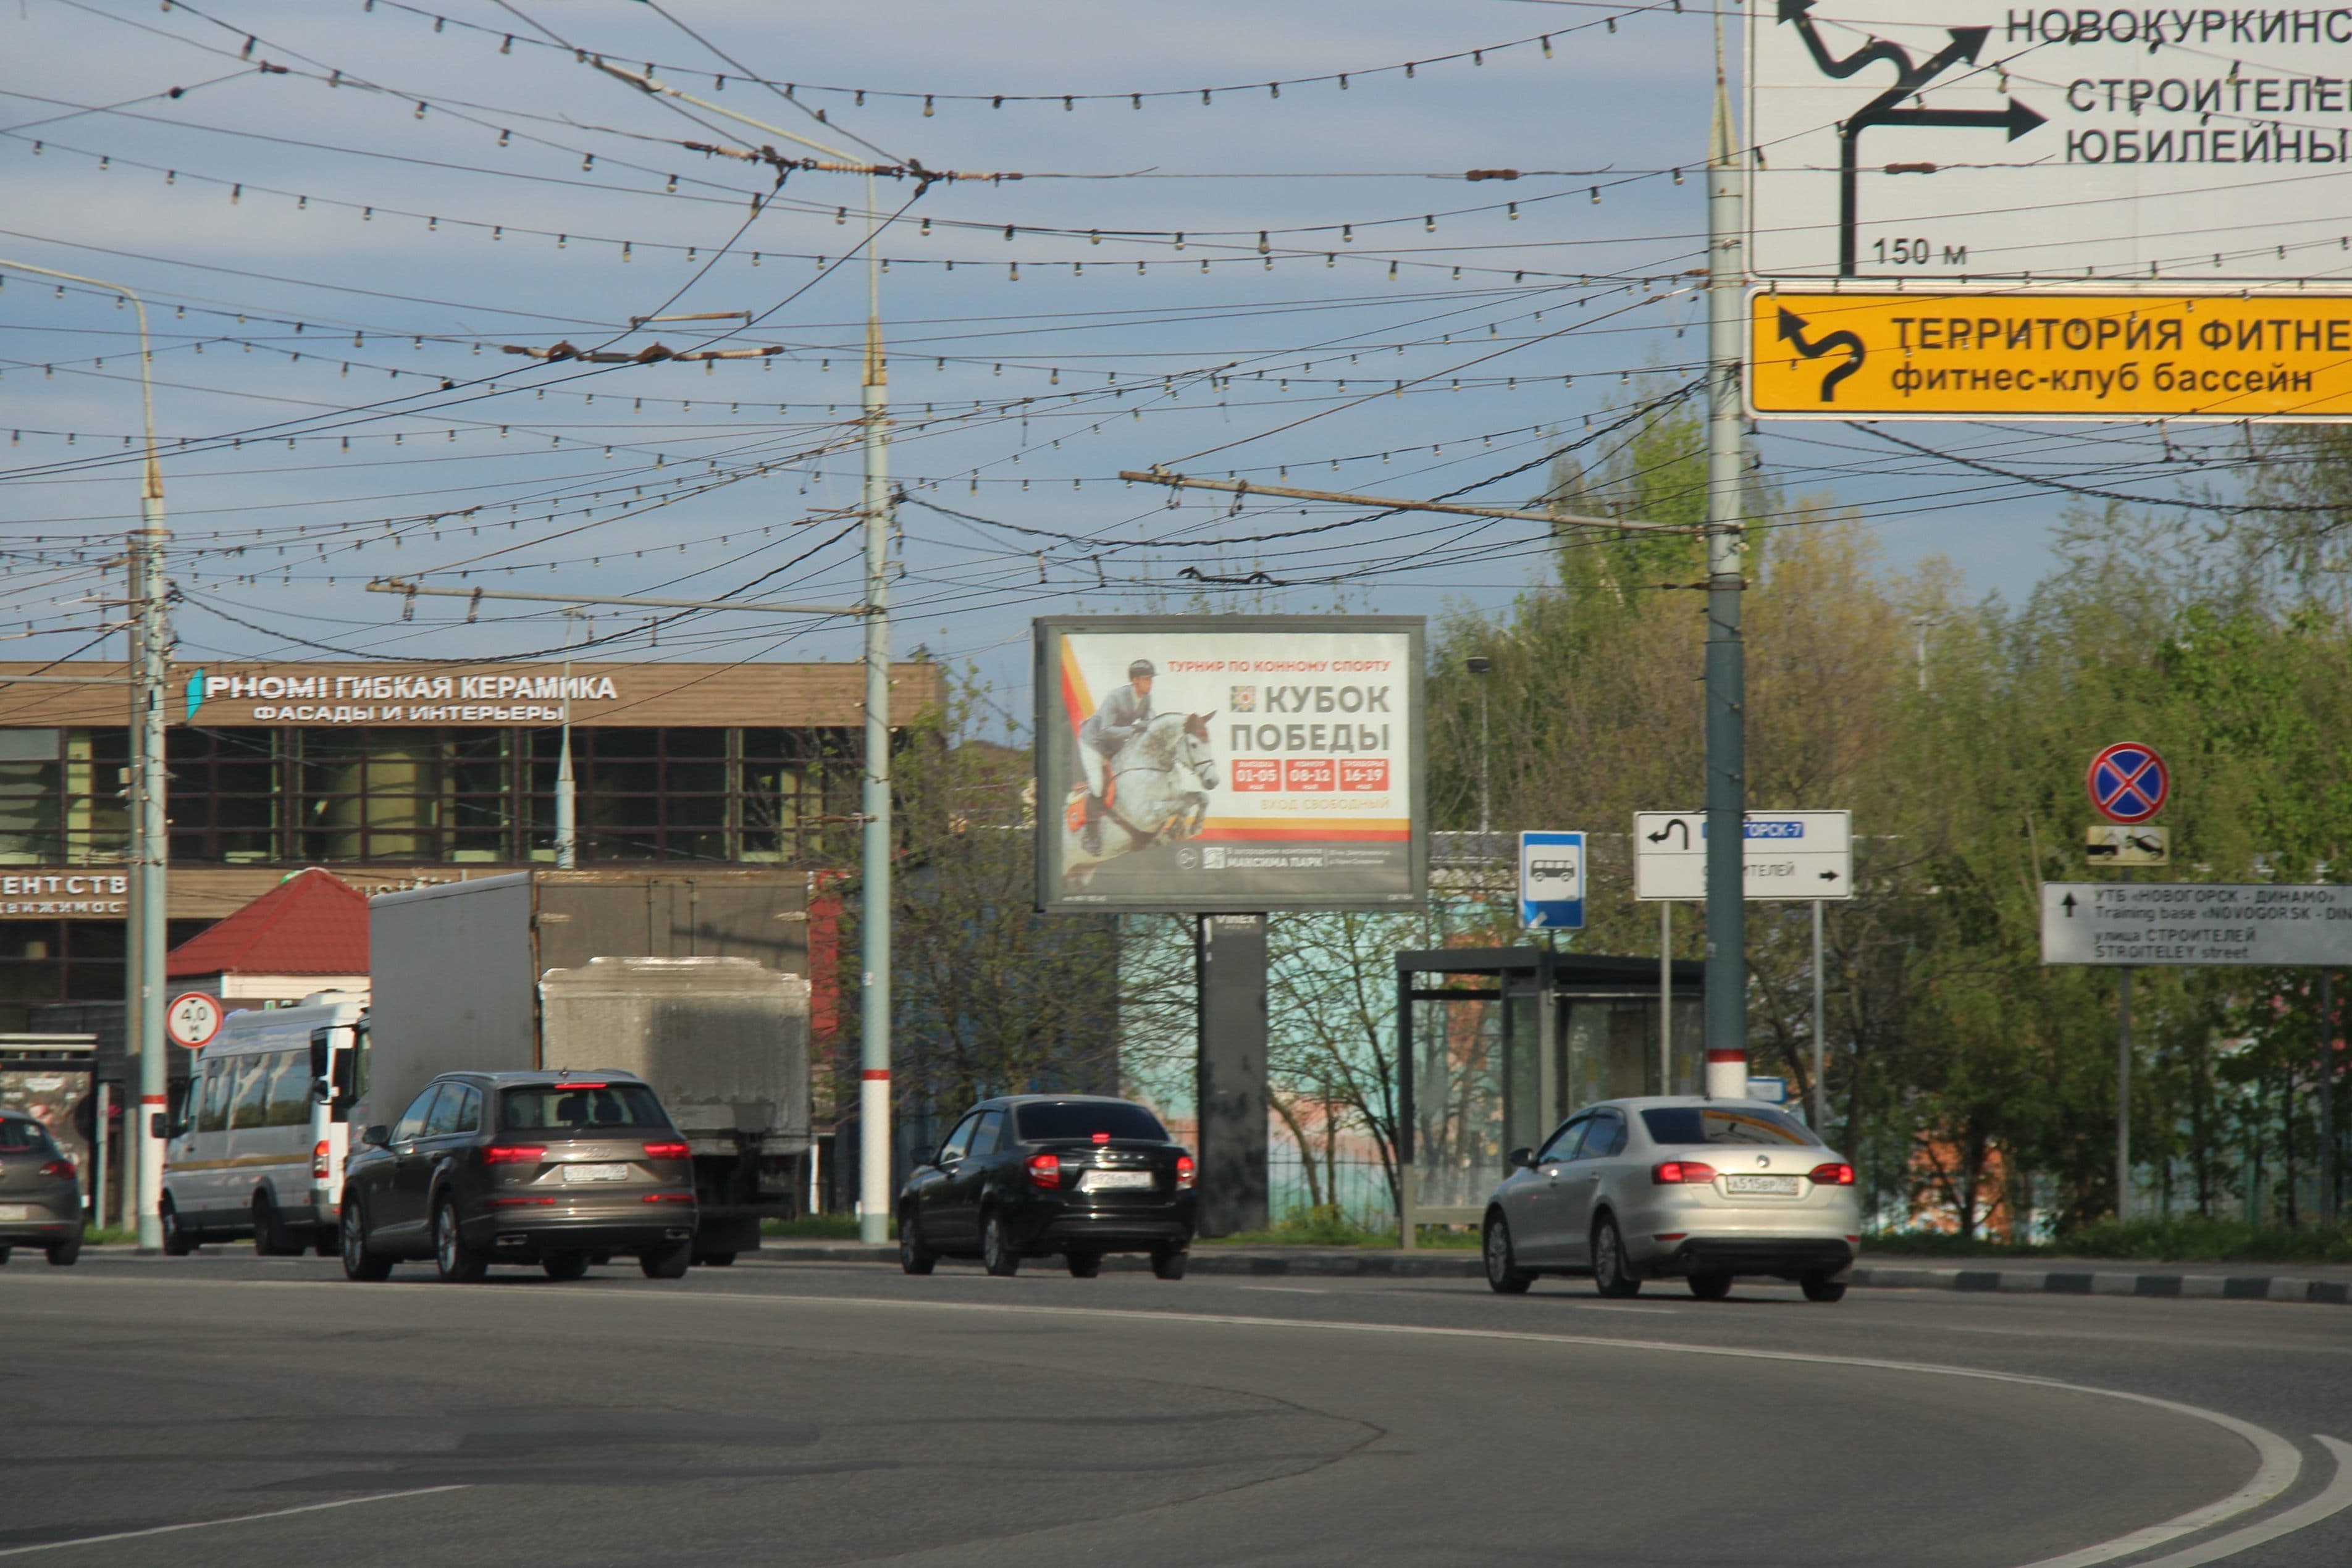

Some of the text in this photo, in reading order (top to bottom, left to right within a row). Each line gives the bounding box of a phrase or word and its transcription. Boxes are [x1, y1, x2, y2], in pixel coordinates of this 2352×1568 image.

[2068, 78, 2352, 112] СТРОИТЕЛЕ
[1873, 238, 1929, 264] 150
[1891, 317, 2351, 351] ТЕРРИТОРИЯ ФИТНЕ
[1891, 360, 2312, 399] фитнес-клуб бассейн
[1167, 660, 1391, 673] ТУРНИР ПО КОННОМУ СПОРТУ
[204, 676, 618, 699] PHOMI ГИБКАЯ КЕРАМИКА
[1264, 685, 1391, 713] КУБОК
[253, 706, 565, 723] ФАСАДЫ И ИНТЕРЬЕРЫ
[1230, 724, 1390, 753] ПОБЕДЫ
[1236, 769, 1277, 782] 01-05
[1290, 769, 1331, 782] 08-12
[1344, 769, 1384, 782] 16-19
[2159, 907, 2196, 919] base
[2146, 927, 2256, 942] СТРОИТЕЛЕЙ
